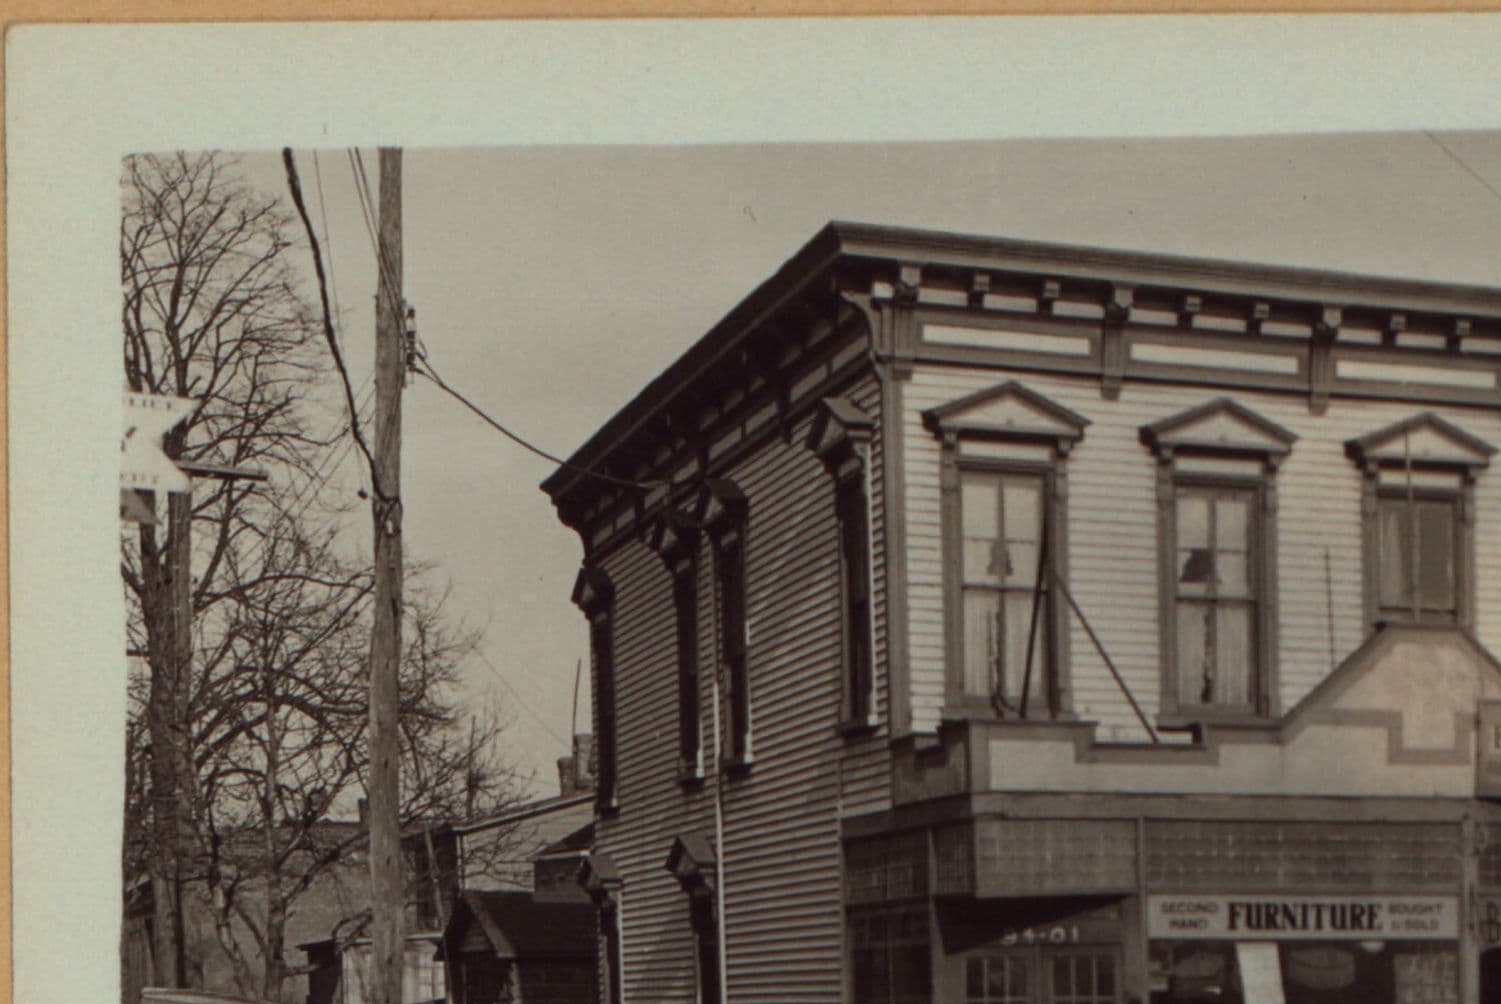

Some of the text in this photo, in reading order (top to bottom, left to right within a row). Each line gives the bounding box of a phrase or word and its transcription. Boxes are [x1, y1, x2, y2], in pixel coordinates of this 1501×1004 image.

[1160, 901, 1219, 915] SECOND
[1387, 903, 1445, 916] BOUGHT
[1226, 901, 1384, 931] FURNITURE
[1169, 918, 1209, 930] HAND
[1404, 918, 1440, 931] SOLD
